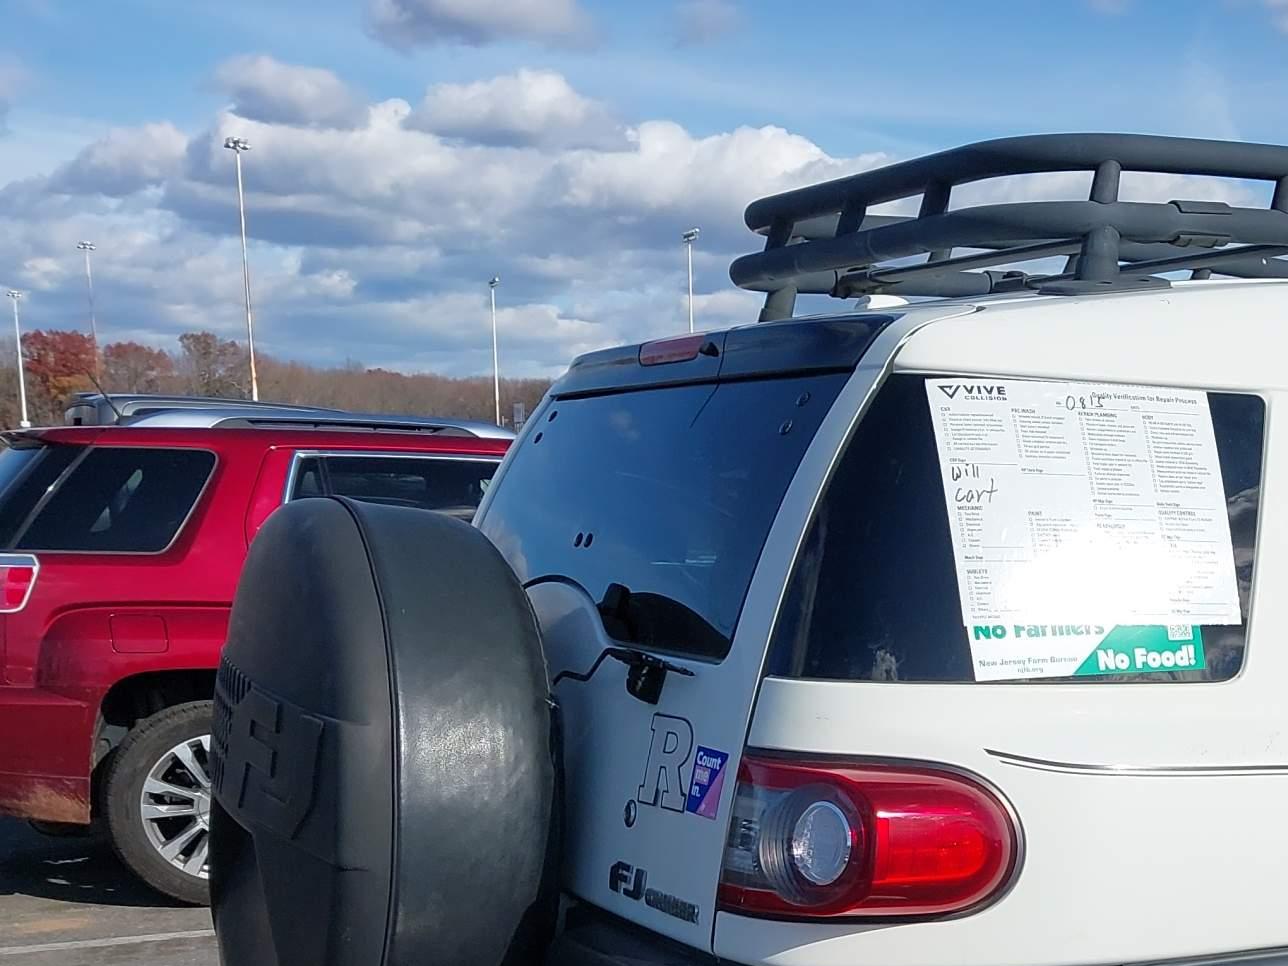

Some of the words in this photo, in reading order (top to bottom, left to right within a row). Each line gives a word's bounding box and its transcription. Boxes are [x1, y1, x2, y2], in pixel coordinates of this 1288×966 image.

[963, 385, 1006, 395] VIVE
[1113, 393, 1147, 402] Verification
[979, 659, 998, 668] New
[1000, 657, 1026, 667] Jersey
[1028, 656, 1048, 665] Farm
[1096, 648, 1130, 671] No
[1133, 644, 1197, 669] Food!
[637, 711, 693, 814] R
[696, 751, 722, 771] Count
[694, 769, 710, 784] me
[608, 860, 649, 901] FJ
